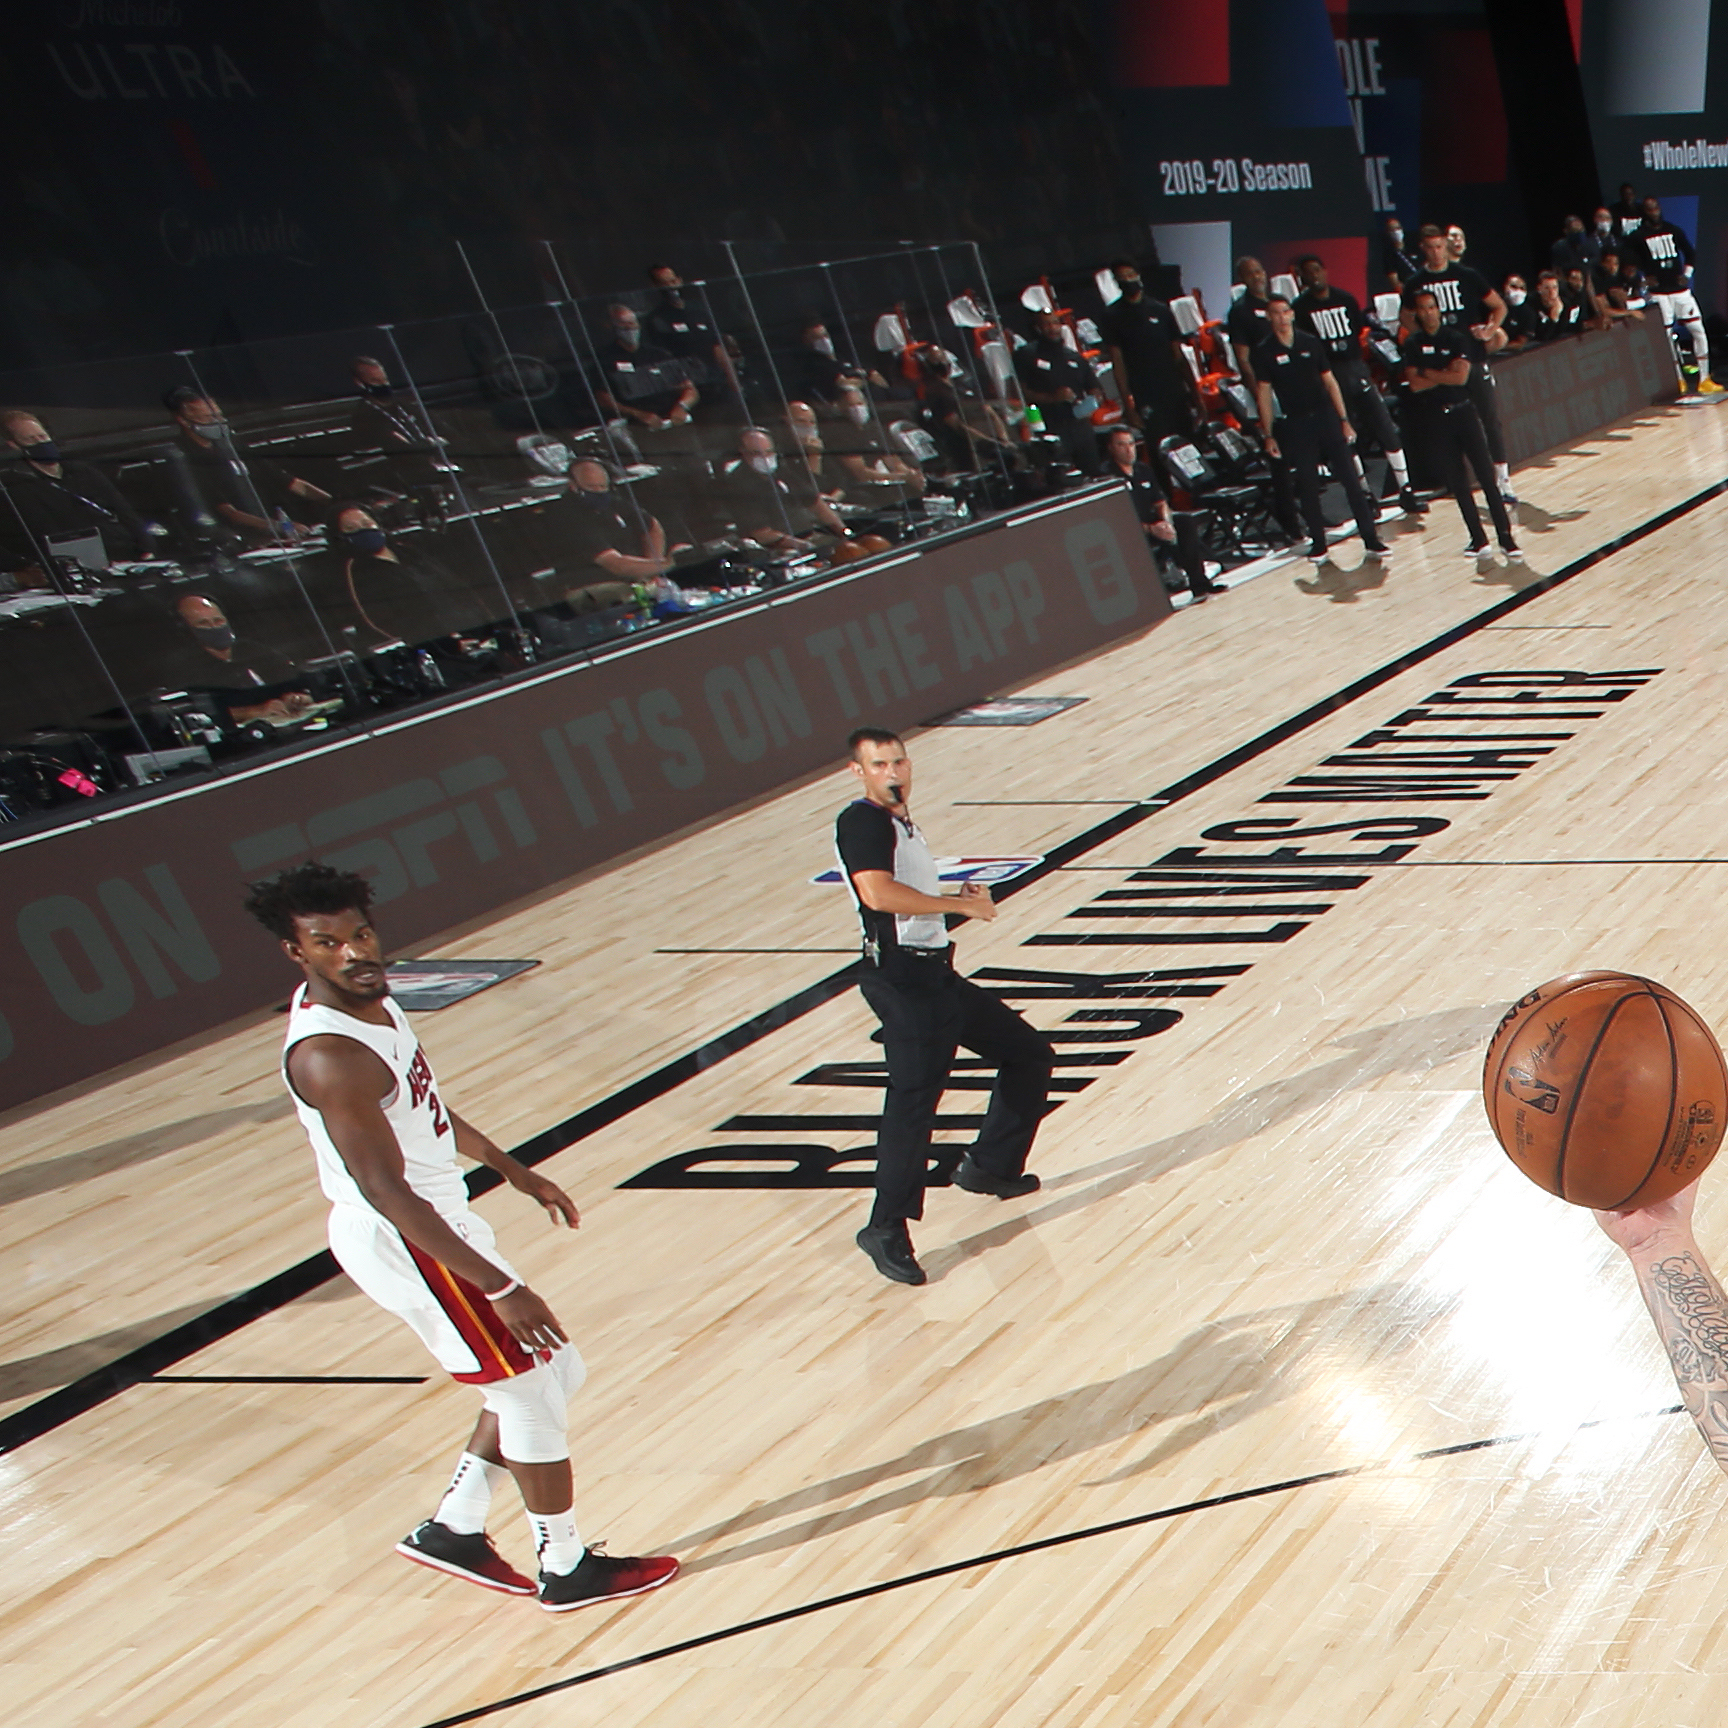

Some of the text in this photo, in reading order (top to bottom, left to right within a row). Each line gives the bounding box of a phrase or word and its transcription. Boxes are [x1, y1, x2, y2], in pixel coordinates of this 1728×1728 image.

[45, 42, 257, 99] ULTRA
[1159, 157, 1313, 196] 2019-20 Season
[1310, 305, 1352, 340] VOTE
[16, 861, 223, 1026] ON
[540, 686, 705, 829] IT'S
[703, 648, 812, 764] ON
[807, 604, 943, 718] THE
[956, 558, 1046, 673] APP
[1019, 816, 1452, 946] LIVES
[1255, 668, 1666, 803] MATTER
